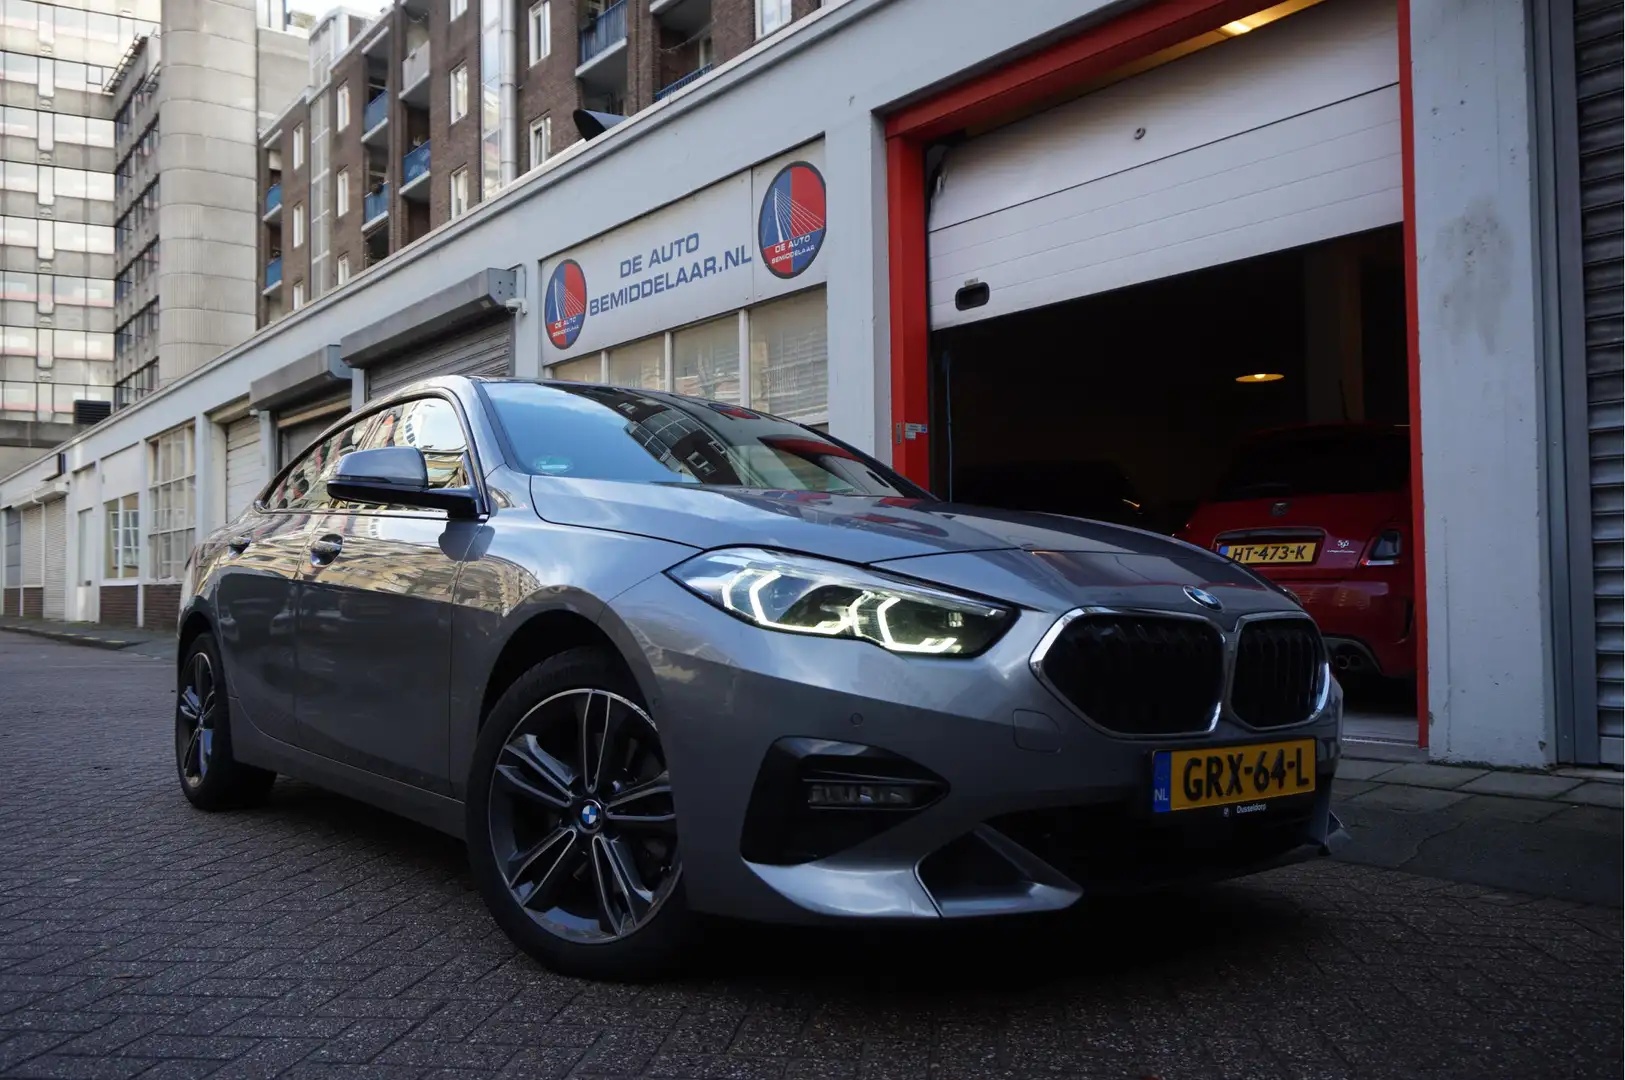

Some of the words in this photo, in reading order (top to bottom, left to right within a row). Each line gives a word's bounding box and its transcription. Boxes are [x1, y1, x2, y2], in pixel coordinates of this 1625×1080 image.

[775, 243, 786, 253] DE
[788, 234, 811, 249] AUTO
[620, 255, 642, 278] DE
[649, 233, 700, 264] AUTO
[771, 244, 815, 264] BEMIDDELAAR
[589, 245, 752, 317] BEMIDDELAAR.NL
[554, 321, 562, 330] DE
[563, 316, 577, 326] AUTO
[1233, 545, 1308, 562] HT-473-K
[1184, 748, 1309, 801] GRX-64-L
[1154, 788, 1168, 801] NL
